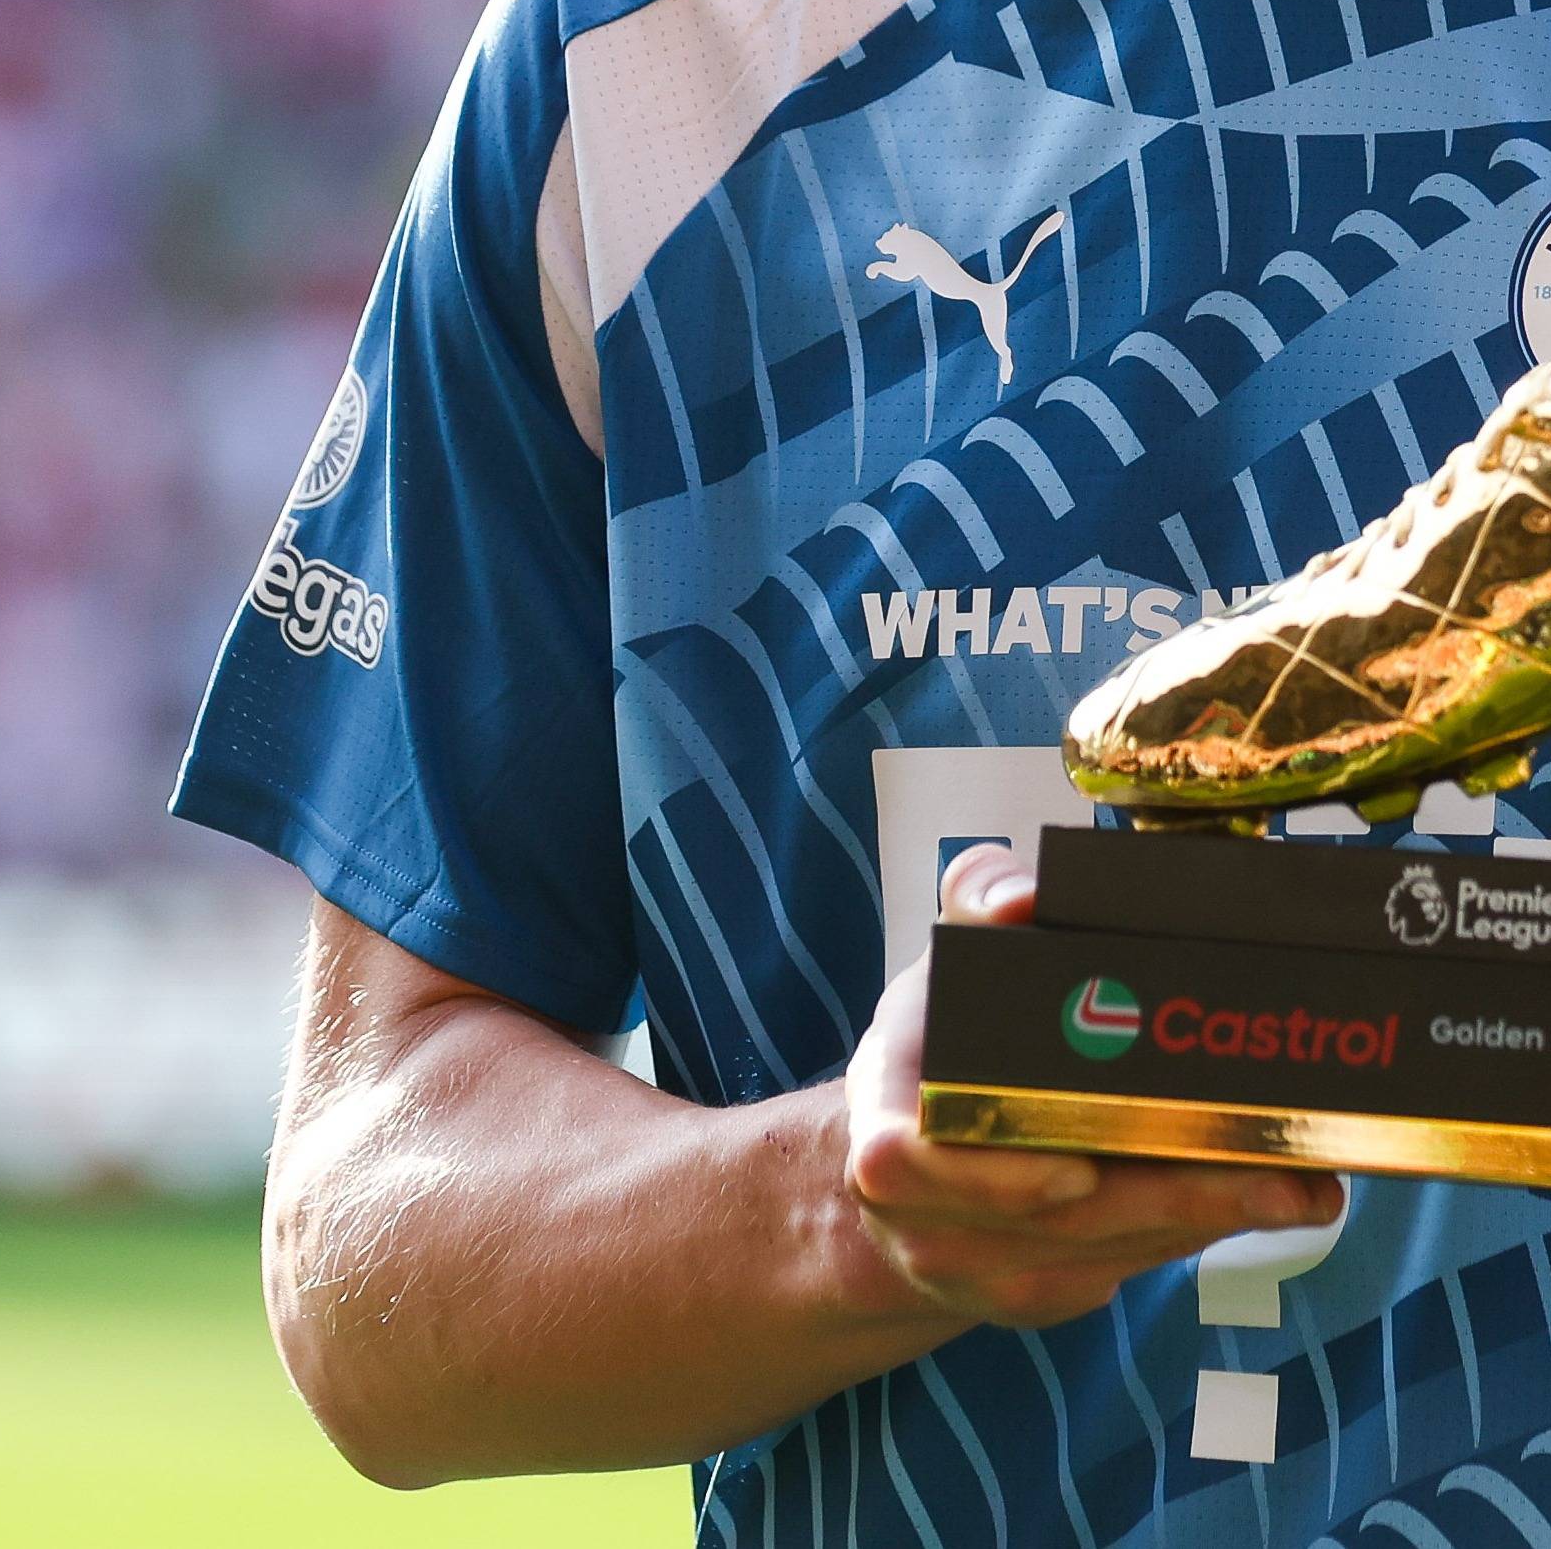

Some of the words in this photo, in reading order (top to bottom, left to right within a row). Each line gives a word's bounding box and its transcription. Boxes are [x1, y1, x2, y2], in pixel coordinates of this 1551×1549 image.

[252, 522, 387, 664] egas
[861, 587, 1184, 660] WHAT'S
[1153, 996, 1400, 1069] Castrol
[1429, 1015, 1545, 1051] Golden
